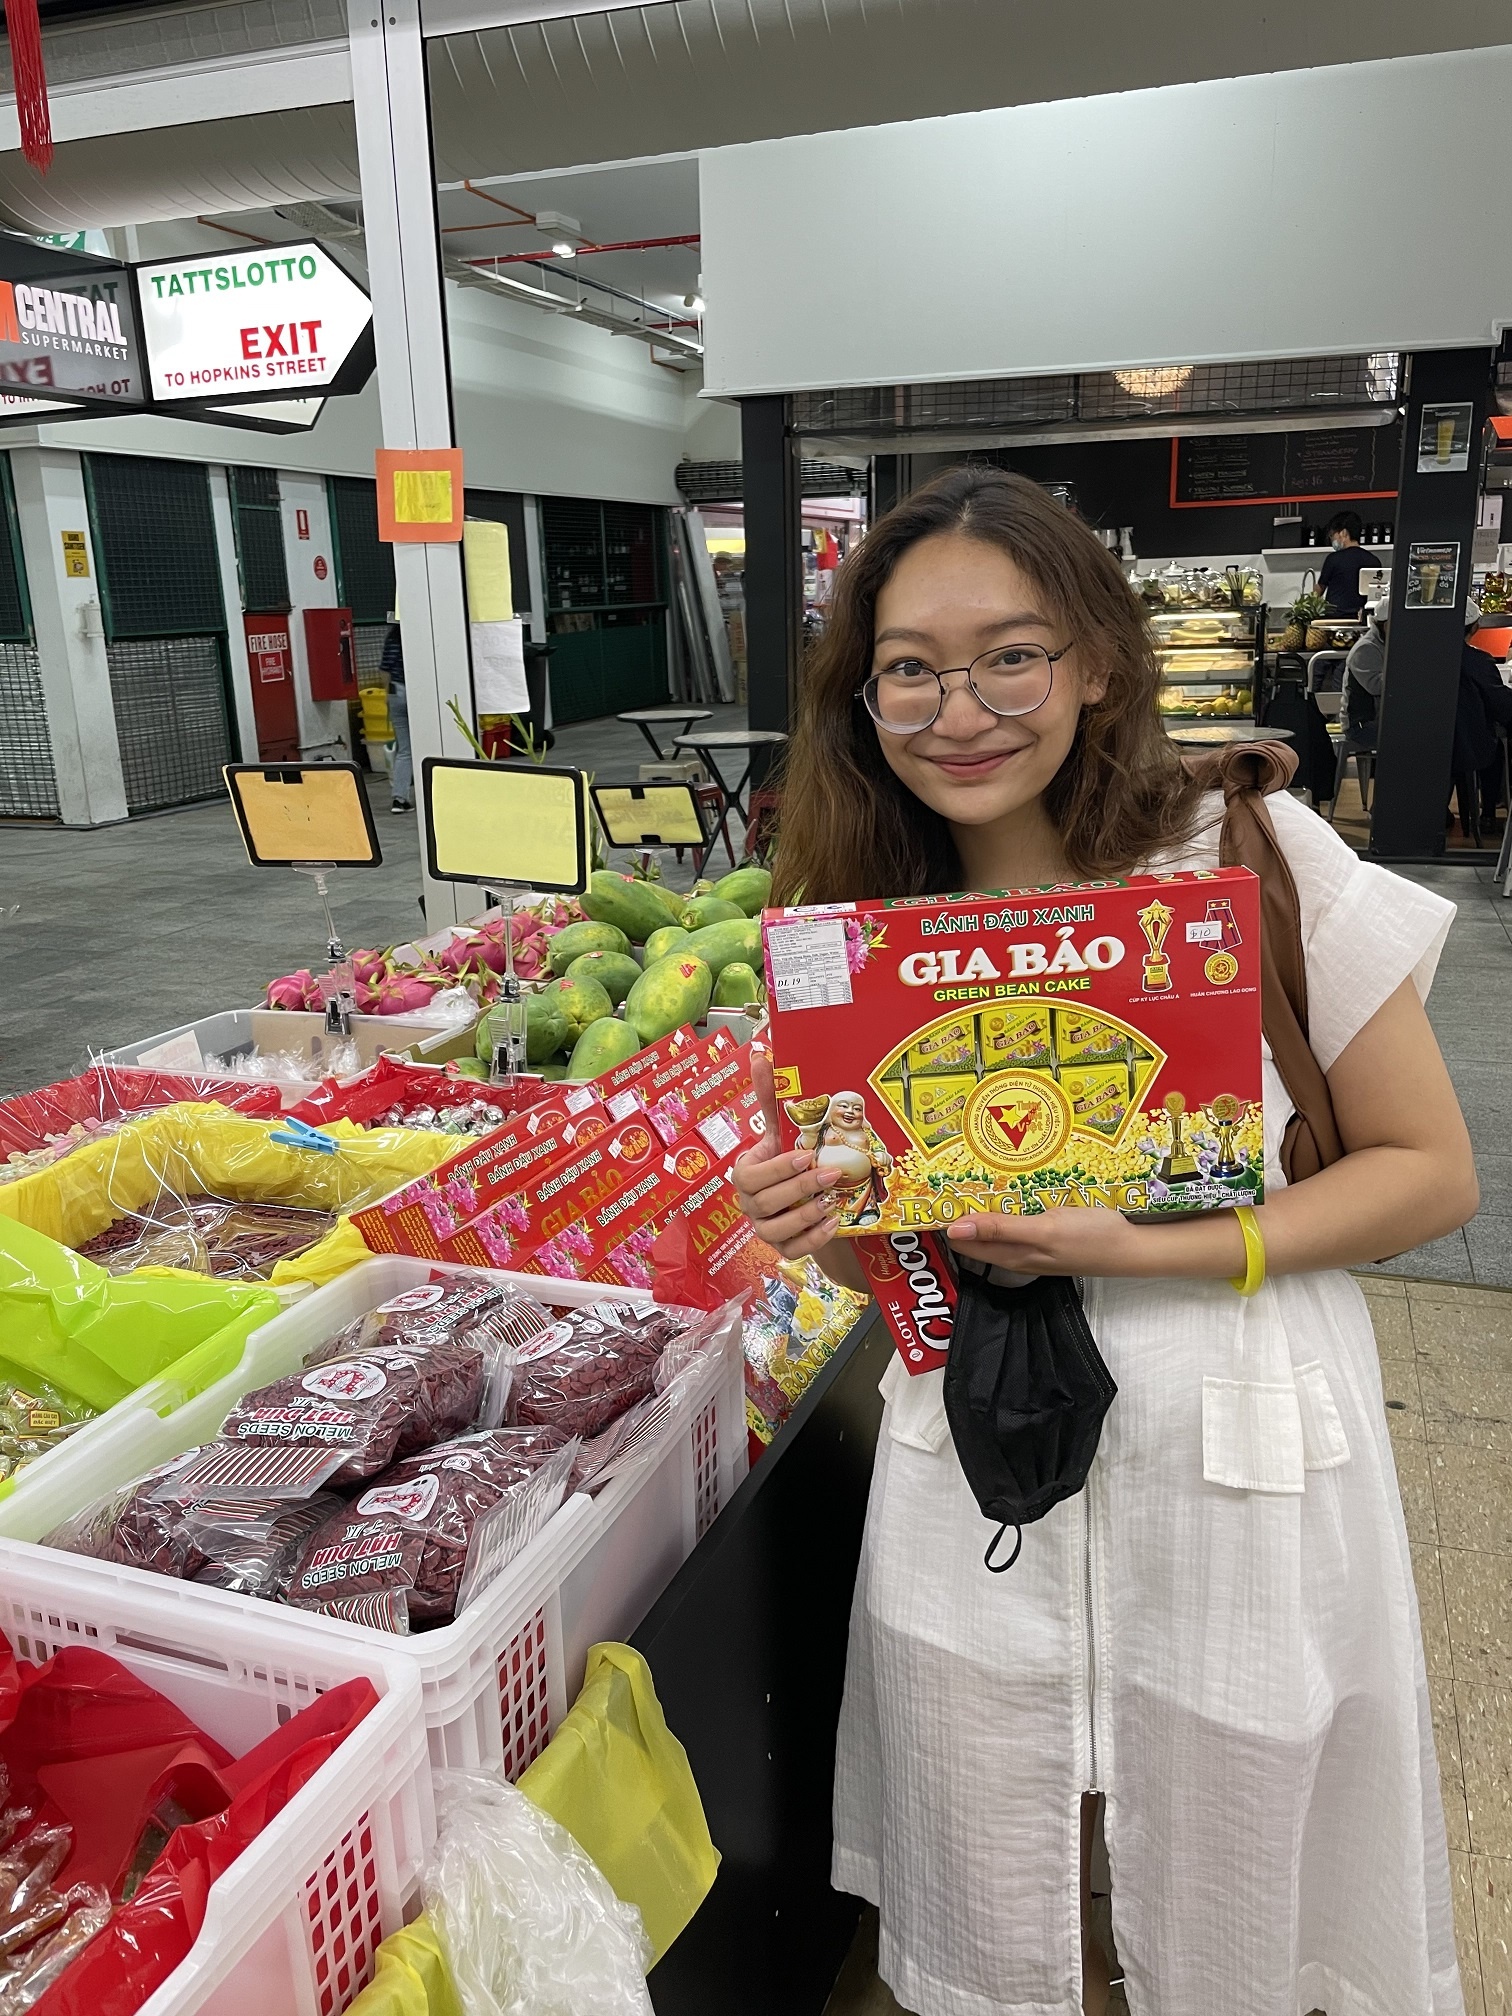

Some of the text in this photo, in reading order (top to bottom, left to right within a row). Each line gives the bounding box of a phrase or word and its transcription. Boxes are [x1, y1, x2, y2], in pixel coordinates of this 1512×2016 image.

[150, 255, 317, 299] TATTSLOTTO
[14, 284, 128, 346] CENTRAL
[22, 332, 128, 361] SUPERMARKET
[239, 320, 322, 360] EXIT
[164, 357, 327, 387] TO HOPKINS STREET
[250, 634, 287, 652] FIRE HOSE
[921, 904, 1095, 936] BÁNH ĐẬU XANH
[898, 947, 1001, 987] GIA
[1006, 926, 1126, 978] BẢO
[777, 978, 801, 988] DL 19
[933, 976, 1091, 1002] GREEN BEAN CAKE
[487, 1137, 558, 1185] BÁNH ĐẬU XANH
[492, 1133, 518, 1158] XANH
[536, 1149, 603, 1203] BÁNH ĐẬU XANH
[698, 1175, 725, 1200] XANH
[540, 1199, 584, 1239] GIA
[578, 1168, 624, 1209] BẢO
[596, 1172, 661, 1228] BÁNH ĐẬU XANH
[899, 1178, 1150, 1226] RỒNG VÀNG
[706, 1256, 726, 1276] KHÔNG
[427, 1305, 470, 1334] SEEDS
[888, 1300, 916, 1348] LOTTE
[778, 1300, 861, 1405] RỒNG VÀNG
[238, 1422, 353, 1440] MELON SEEDS
[301, 1553, 402, 1590] MELON SEEDS
